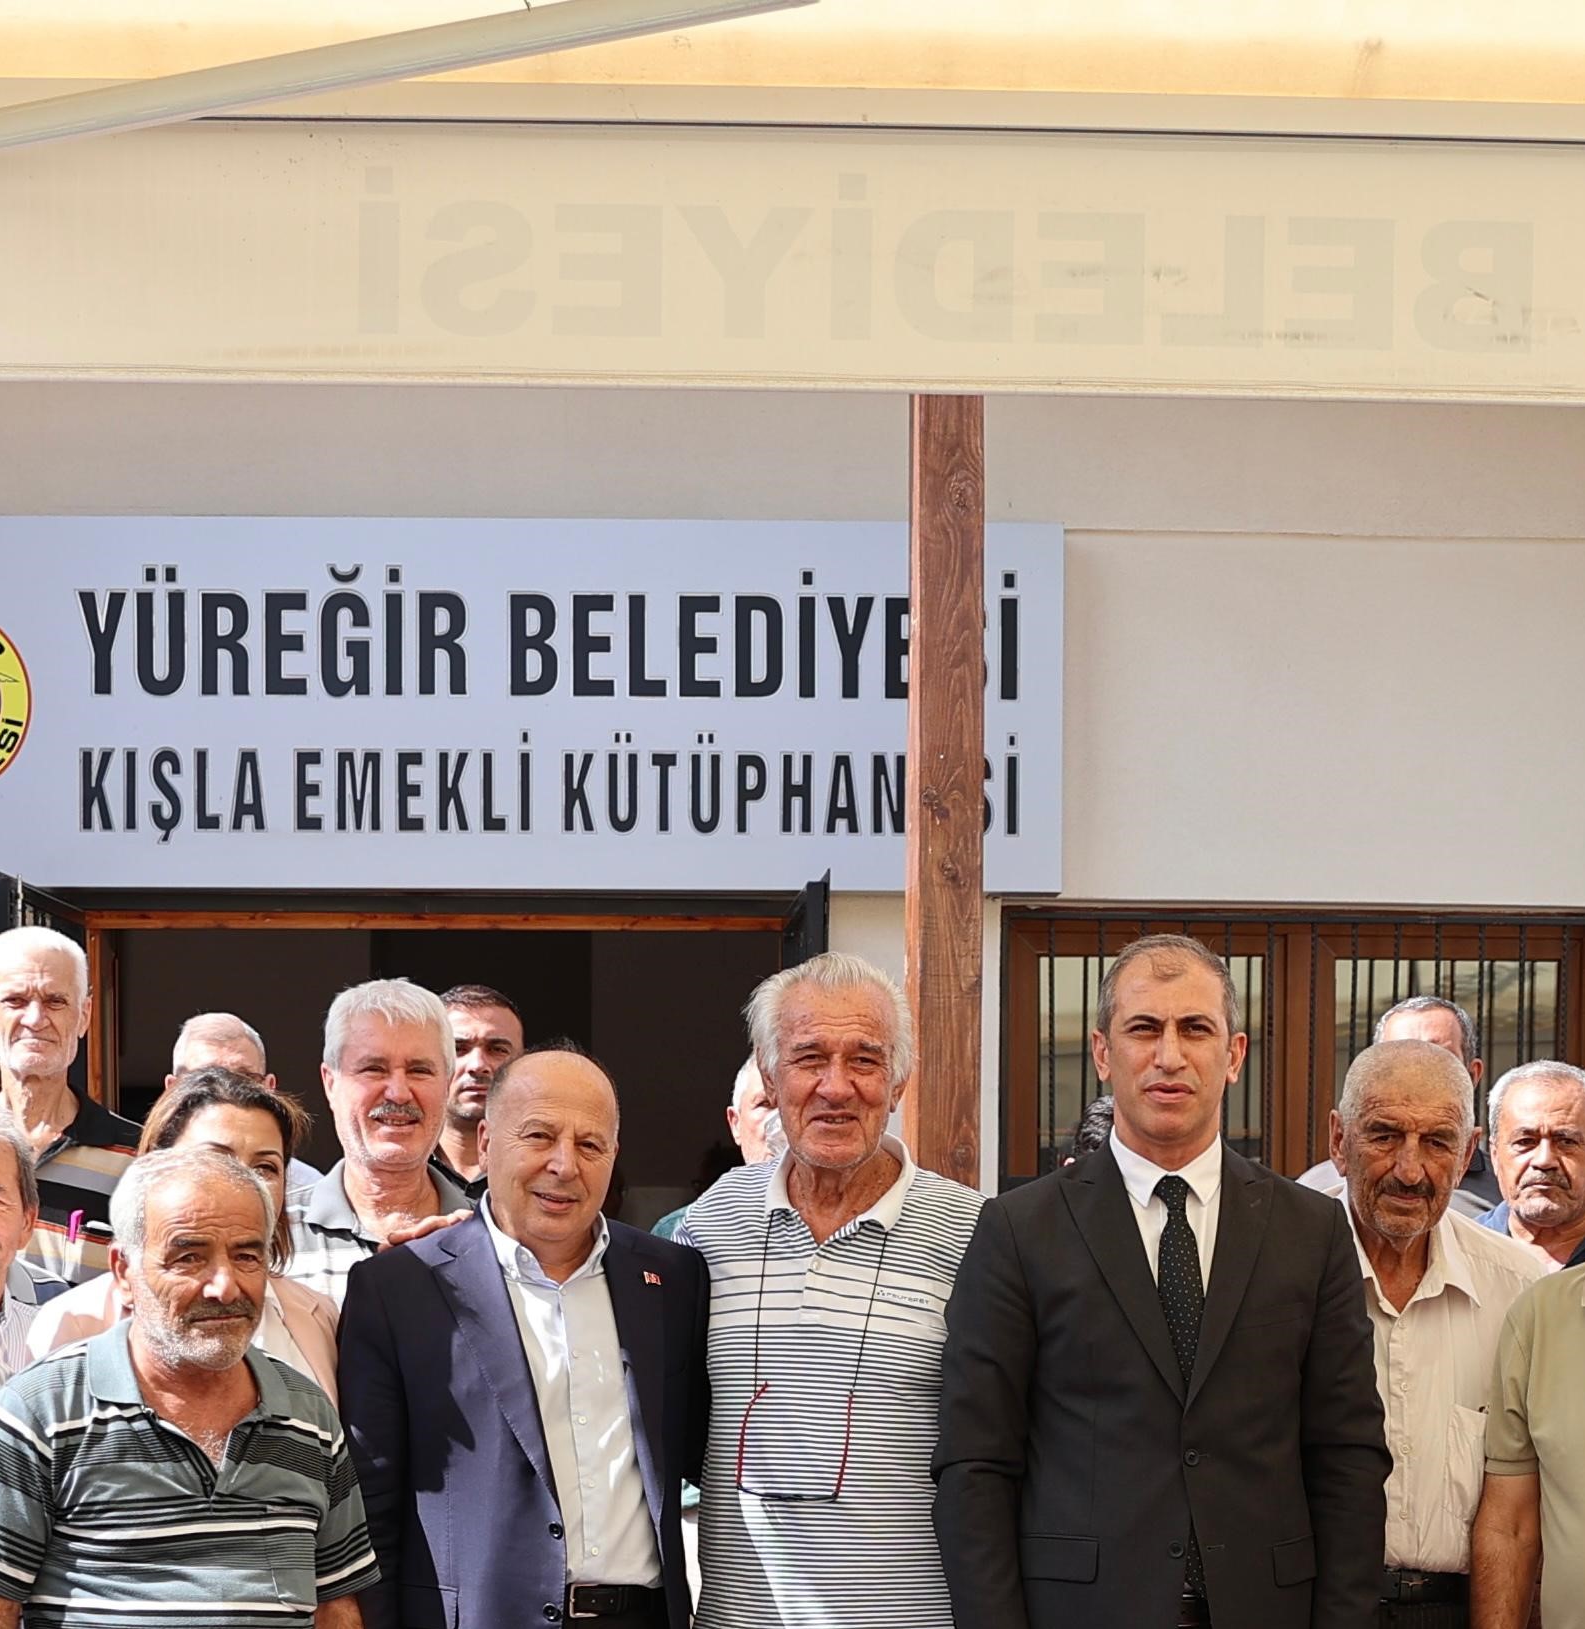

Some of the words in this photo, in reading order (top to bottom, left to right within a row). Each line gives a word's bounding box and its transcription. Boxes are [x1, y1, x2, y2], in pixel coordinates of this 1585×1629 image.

[77, 566, 468, 698] YÜREĞİR
[510, 570, 1019, 701] BELEDİYEİ
[82, 750, 266, 843] KIŞLA
[296, 731, 531, 832] EMEKLİ
[564, 732, 1021, 835] KÜTÜPHANİ
